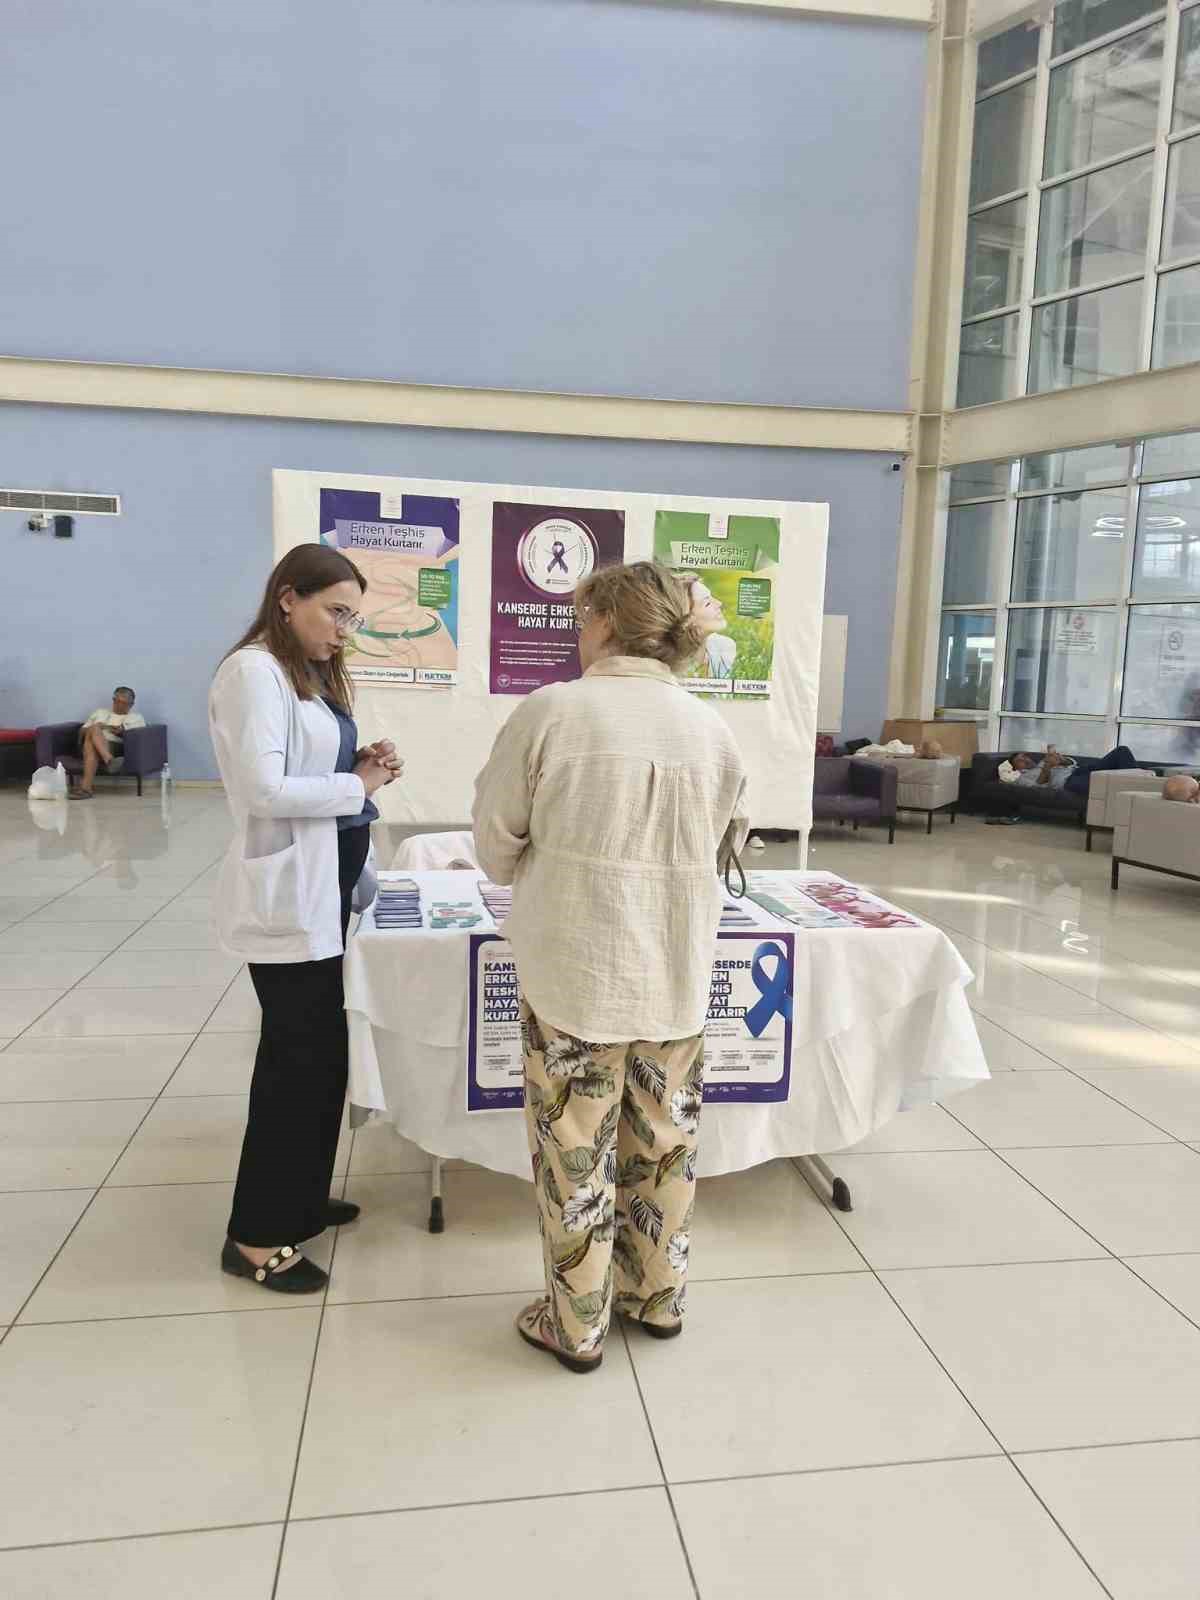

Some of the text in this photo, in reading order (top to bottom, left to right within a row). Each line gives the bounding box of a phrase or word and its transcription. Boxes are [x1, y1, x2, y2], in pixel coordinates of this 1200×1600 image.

[351, 522, 384, 535] Erken
[351, 536, 381, 547] Hayat
[681, 543, 712, 554] Erken
[680, 555, 708, 566] Hayat
[497, 602, 577, 617] KANSERDE ERKE
[518, 616, 574, 630] HAYAT KURT
[712, 960, 752, 969] SERDE
[484, 974, 517, 985] ERKE
[712, 972, 728, 981] EN
[484, 987, 517, 997] TESH
[484, 999, 519, 1009] HAYA
[705, 1008, 747, 1018] RTARIR
